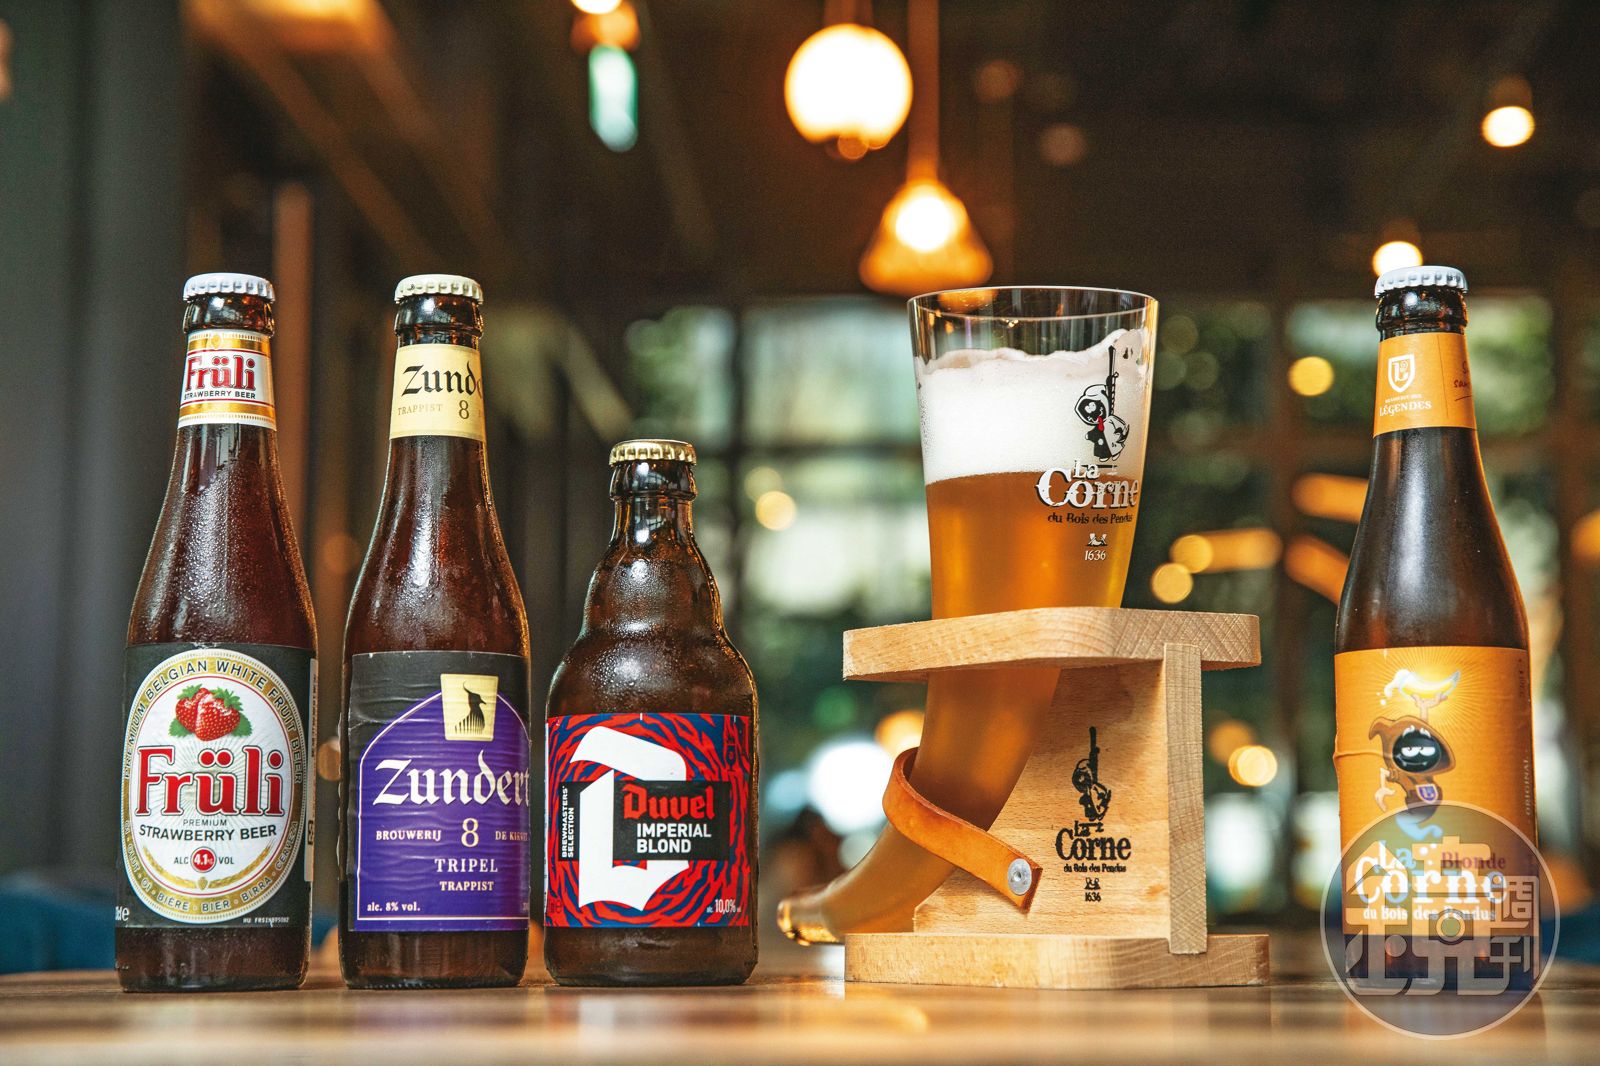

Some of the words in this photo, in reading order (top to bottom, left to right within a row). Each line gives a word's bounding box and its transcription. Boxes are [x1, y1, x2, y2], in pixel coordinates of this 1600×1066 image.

[185, 355, 256, 391] Früli
[184, 390, 232, 400] STRAWBERRY
[234, 391, 256, 399] BEER
[398, 404, 443, 415] TRAPPIST
[459, 400, 469, 419] 8
[1073, 460, 1100, 479] La
[1035, 467, 1138, 508] Corne
[1047, 513, 1062, 523] du
[1066, 513, 1089, 524] Bois
[1092, 514, 1108, 524] des
[1084, 550, 1106, 560] 1636
[145, 660, 208, 700] BELGIAN
[216, 660, 267, 690] WHITE
[267, 687, 297, 732] FRUIT
[290, 736, 303, 784] BEER
[134, 745, 286, 817] Früli
[622, 783, 716, 820] Duvel
[139, 824, 235, 842] STRAWBERRY
[240, 824, 277, 840] BEER
[376, 830, 442, 842] BROUWERIJ
[461, 818, 479, 848] 8
[495, 831, 507, 841] DE
[567, 807, 575, 858] SELECTION
[637, 823, 712, 838] IMPERIAL
[275, 820, 298, 871] CERVEZA
[637, 839, 692, 853] BLOND
[1055, 827, 1132, 860] Corne
[174, 857, 189, 865] ALC
[218, 857, 235, 865] VOL
[1378, 841, 1416, 870] La
[1441, 852, 1507, 870] Blonde
[435, 859, 498, 873] TRIPEL
[1064, 864, 1072, 873] du
[1074, 864, 1088, 873] Bois
[1089, 864, 1101, 873] des
[1102, 864, 1126, 873] Pendus
[440, 881, 494, 891] TRAPPIST
[1355, 856, 1508, 904] Corne
[241, 876, 272, 902] BIRRA
[1085, 892, 1101, 902] 1636
[202, 900, 230, 912] BIER
[367, 902, 383, 912] alc.
[386, 902, 399, 912] 8%
[401, 902, 421, 912] vol.
[1381, 908, 1408, 921] Bois
